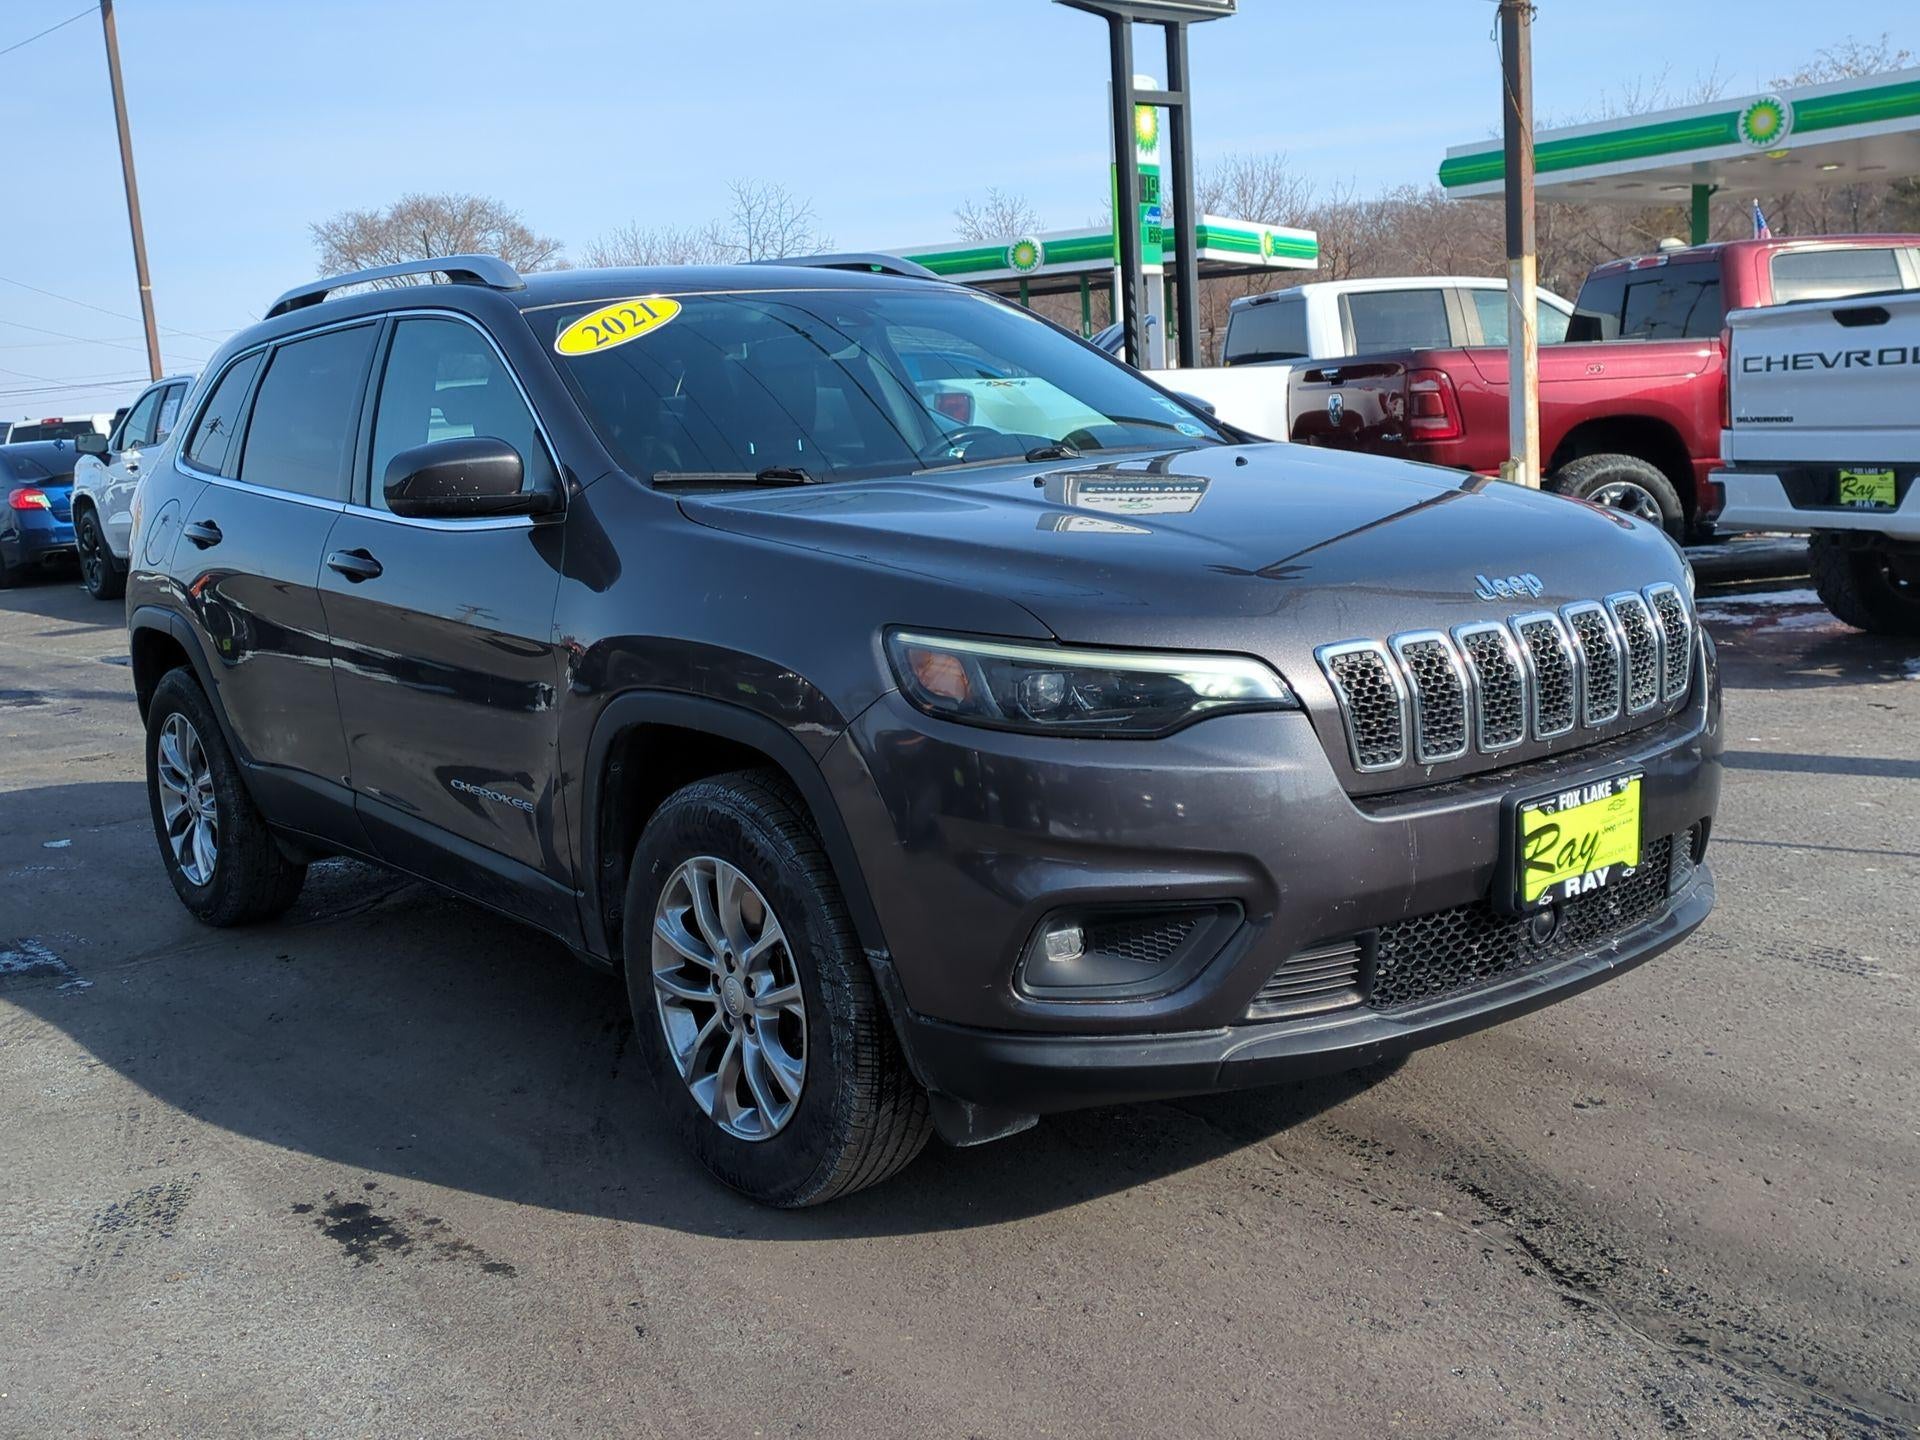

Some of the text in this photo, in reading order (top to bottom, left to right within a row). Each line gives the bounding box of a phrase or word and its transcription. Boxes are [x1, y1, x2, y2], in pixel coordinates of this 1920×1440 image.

[581, 302, 660, 346] 2021
[1841, 476, 1877, 500] Ray
[1474, 573, 1544, 600] Jeep
[450, 779, 534, 813] CHEROKEE
[1559, 789, 1581, 811] FOX
[1583, 780, 1612, 804] LAKE
[1524, 822, 1600, 874] Ray
[1565, 866, 1610, 899] RAY
